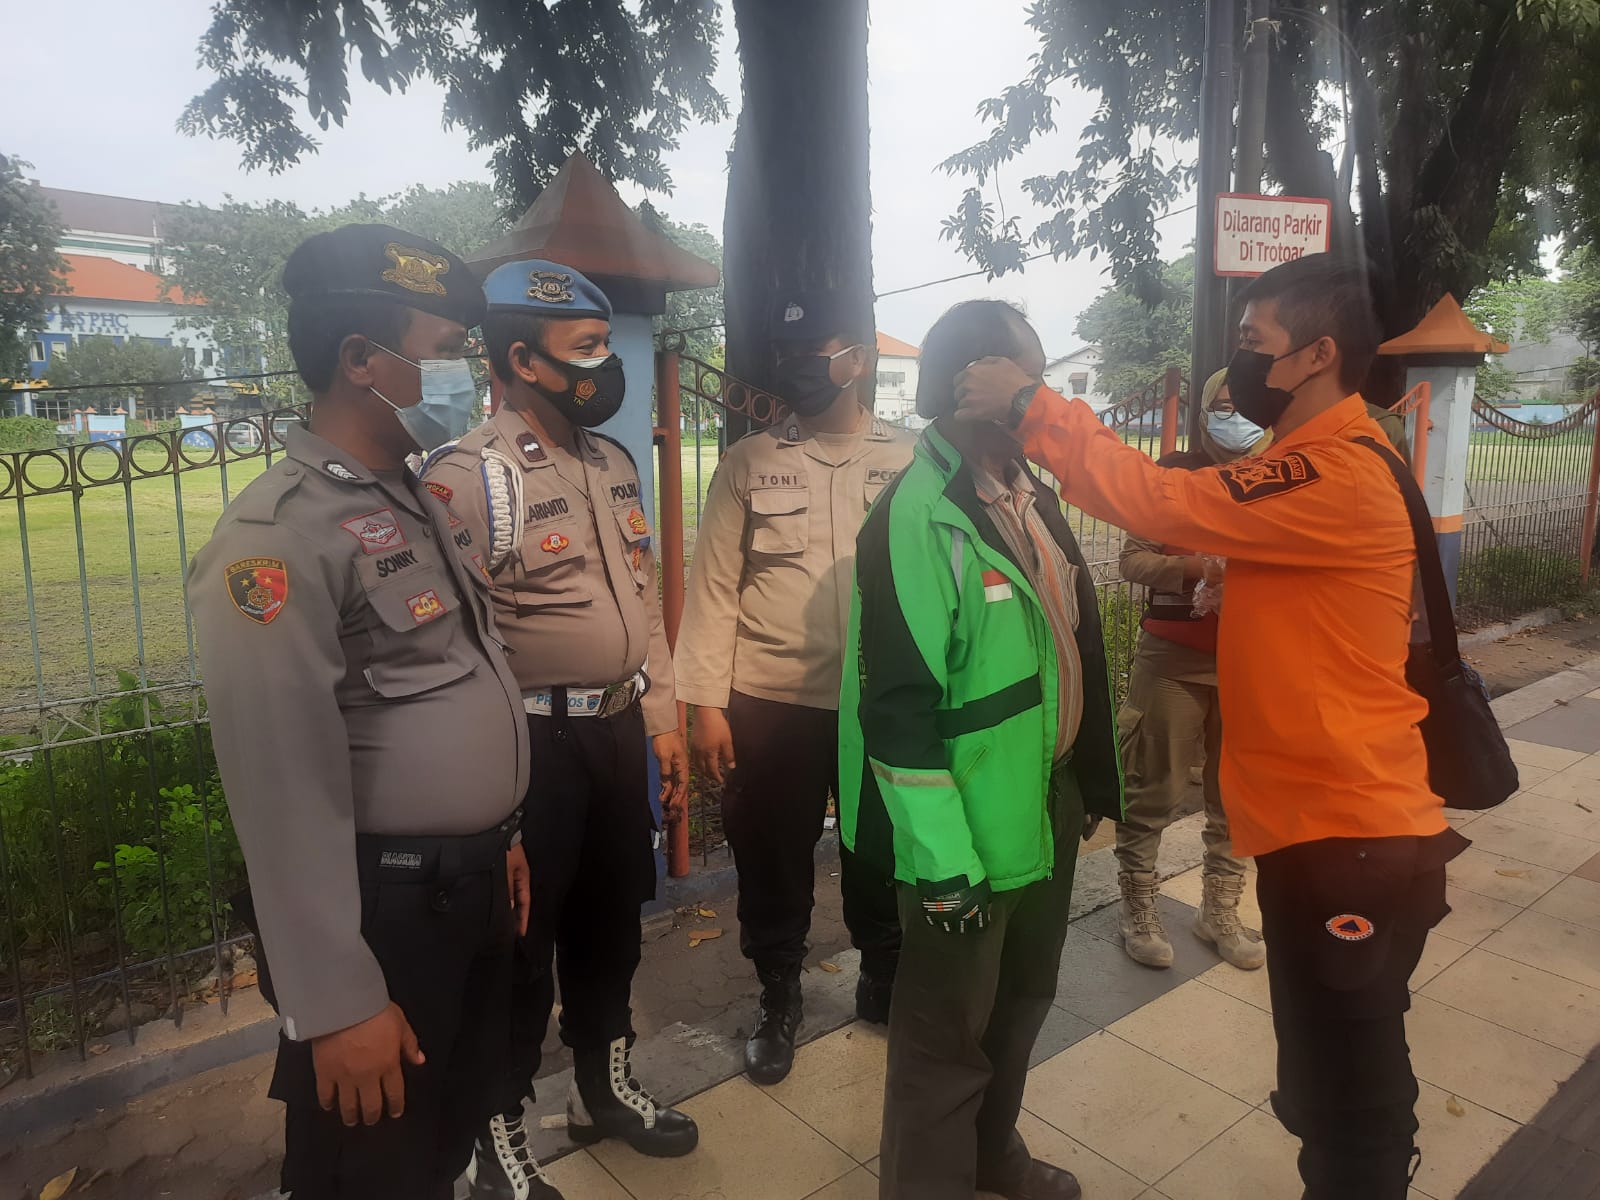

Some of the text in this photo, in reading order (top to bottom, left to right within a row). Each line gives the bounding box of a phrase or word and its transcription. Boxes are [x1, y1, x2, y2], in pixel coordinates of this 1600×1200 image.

[1223, 210, 1322, 239] Dilarang Parkir
[1239, 240, 1253, 262] Di
[758, 475, 797, 486] TONI
[376, 549, 419, 578] SONNY
